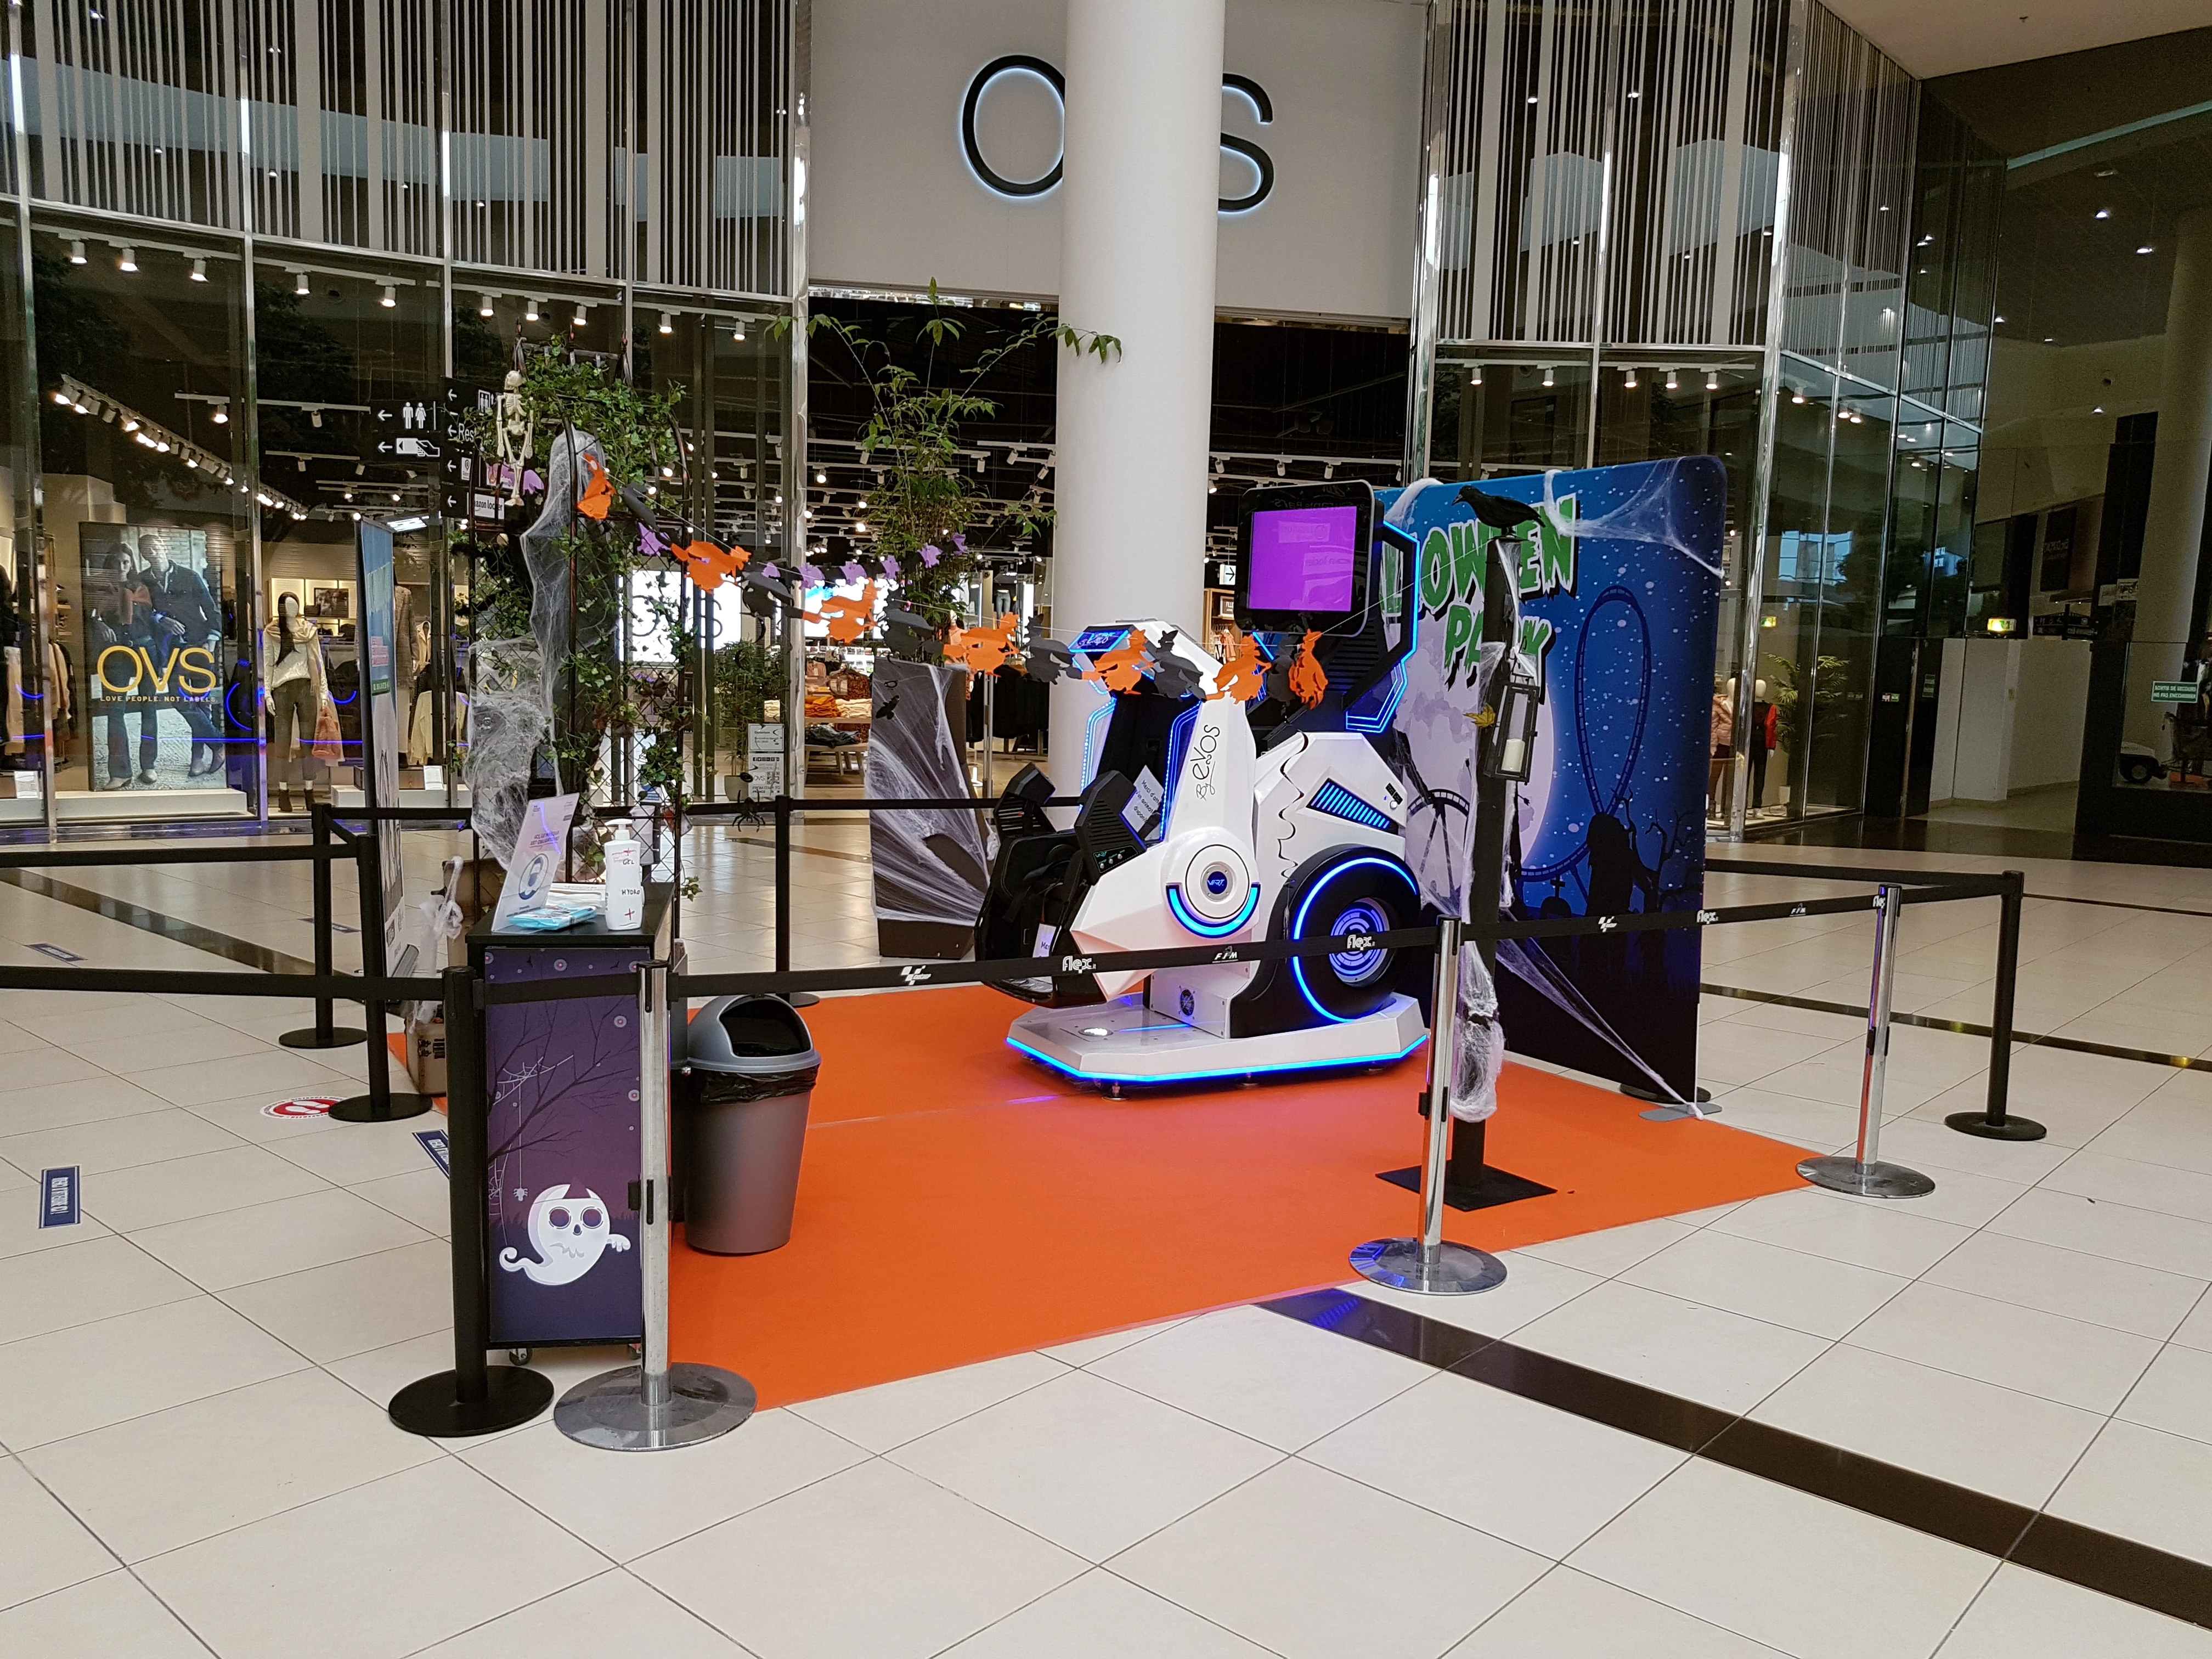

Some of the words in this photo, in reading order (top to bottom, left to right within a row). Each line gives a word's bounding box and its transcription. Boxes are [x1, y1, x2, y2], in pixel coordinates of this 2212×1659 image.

[475, 500, 487, 509] azon
[487, 500, 503, 511] locer
[97, 645, 217, 693] OVS
